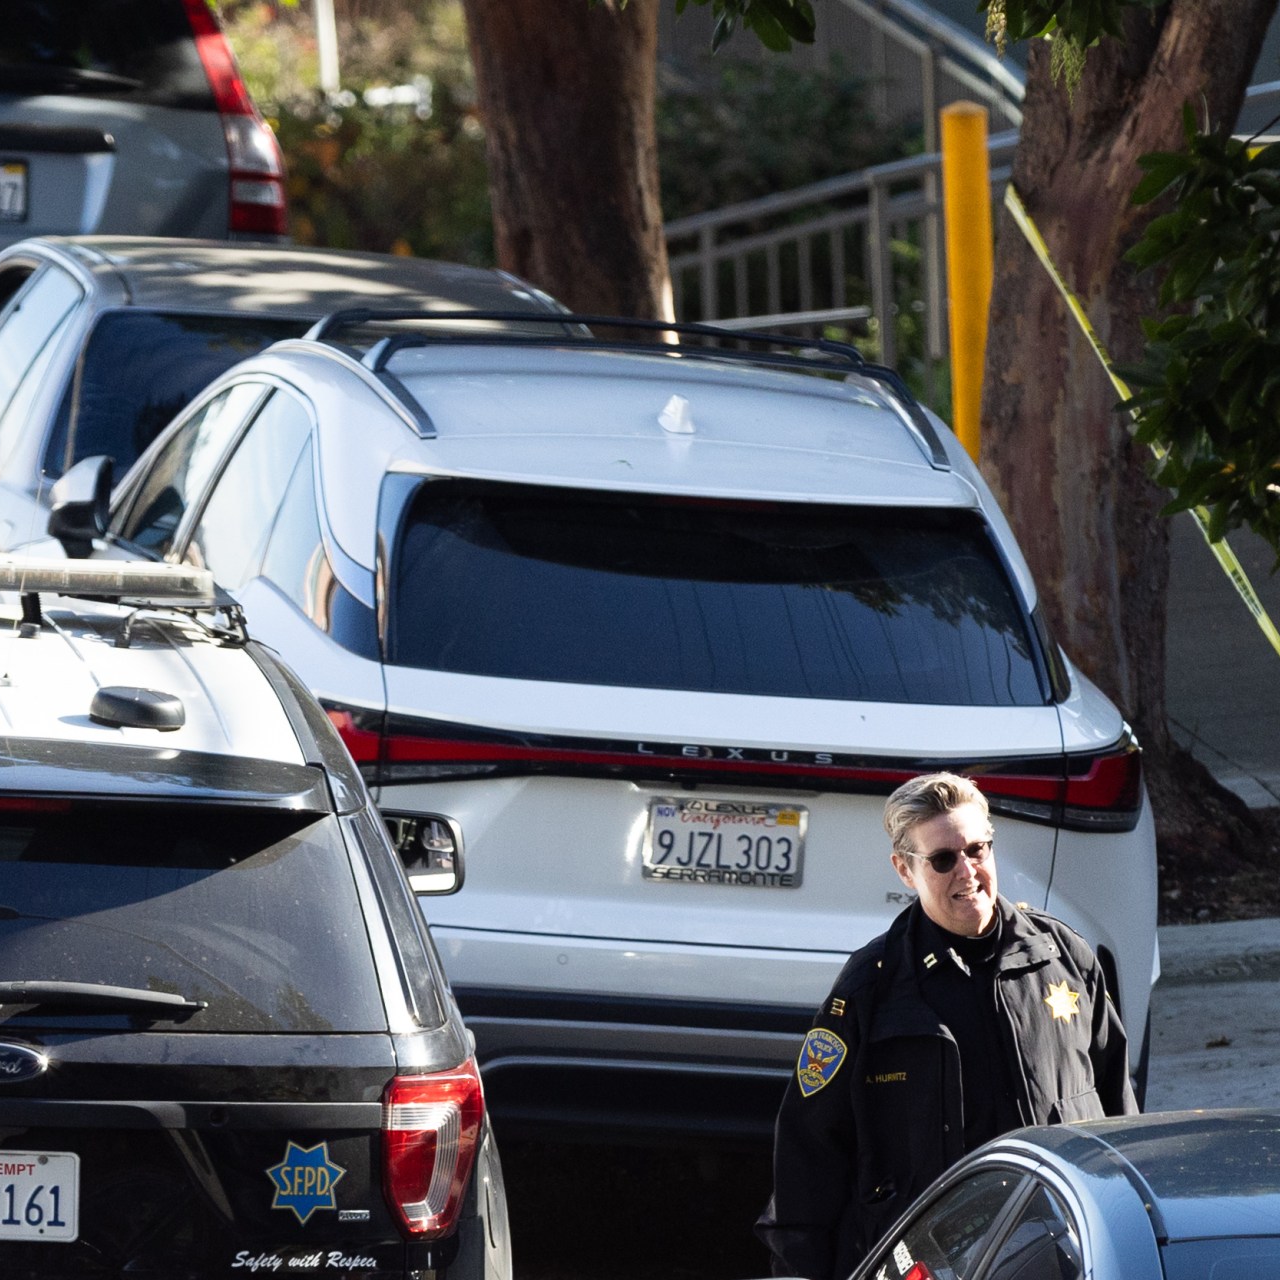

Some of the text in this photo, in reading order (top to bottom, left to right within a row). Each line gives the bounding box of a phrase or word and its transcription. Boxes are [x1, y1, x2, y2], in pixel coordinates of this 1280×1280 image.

[638, 742, 833, 765] LEXUS
[656, 806, 677, 817] NOV
[704, 801, 769, 815] LEXUS
[656, 829, 793, 872] 9JZL303
[651, 867, 794, 887] SERRAMONTE
[231, 1251, 283, 1272] Safety
[288, 1252, 323, 1267] with
